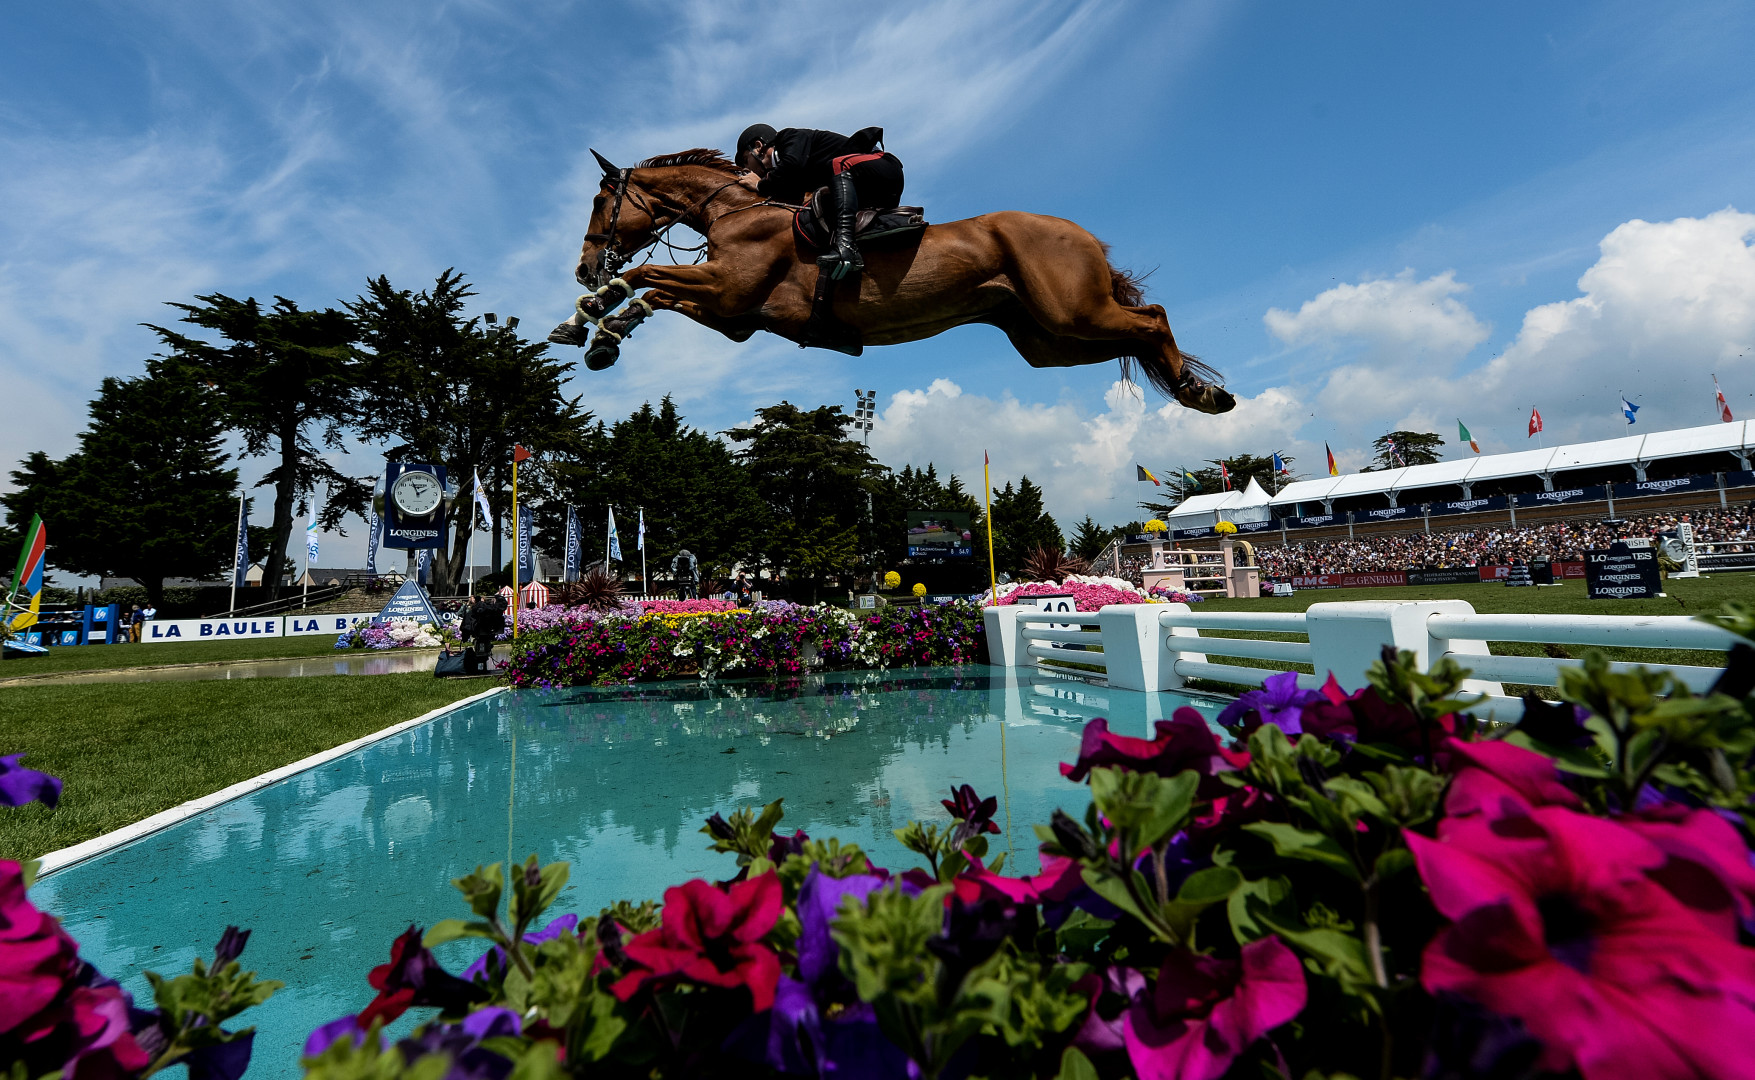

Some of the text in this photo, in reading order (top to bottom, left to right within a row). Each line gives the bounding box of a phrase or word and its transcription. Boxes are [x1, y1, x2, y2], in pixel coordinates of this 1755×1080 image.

[1636, 478, 1690, 490] LONGINES
[1536, 489, 1584, 500] LONGINES
[1447, 499, 1489, 508] LONGINES
[1369, 508, 1406, 516] LONGINES
[1300, 515, 1333, 524] LONGINES
[1239, 522, 1268, 530] LONGINES
[390, 529, 439, 537] LONGINES
[1183, 528, 1210, 536] LONGINES
[519, 516, 527, 569] LONGINES
[567, 518, 577, 568] LONGINES
[1683, 525, 1697, 572] LONGINES
[1292, 576, 1329, 586] RMC
[1356, 574, 1403, 585] GENERALI
[1595, 586, 1647, 595] LONGINES
[152, 621, 275, 638] LA BAULE
[293, 619, 320, 632] LA
